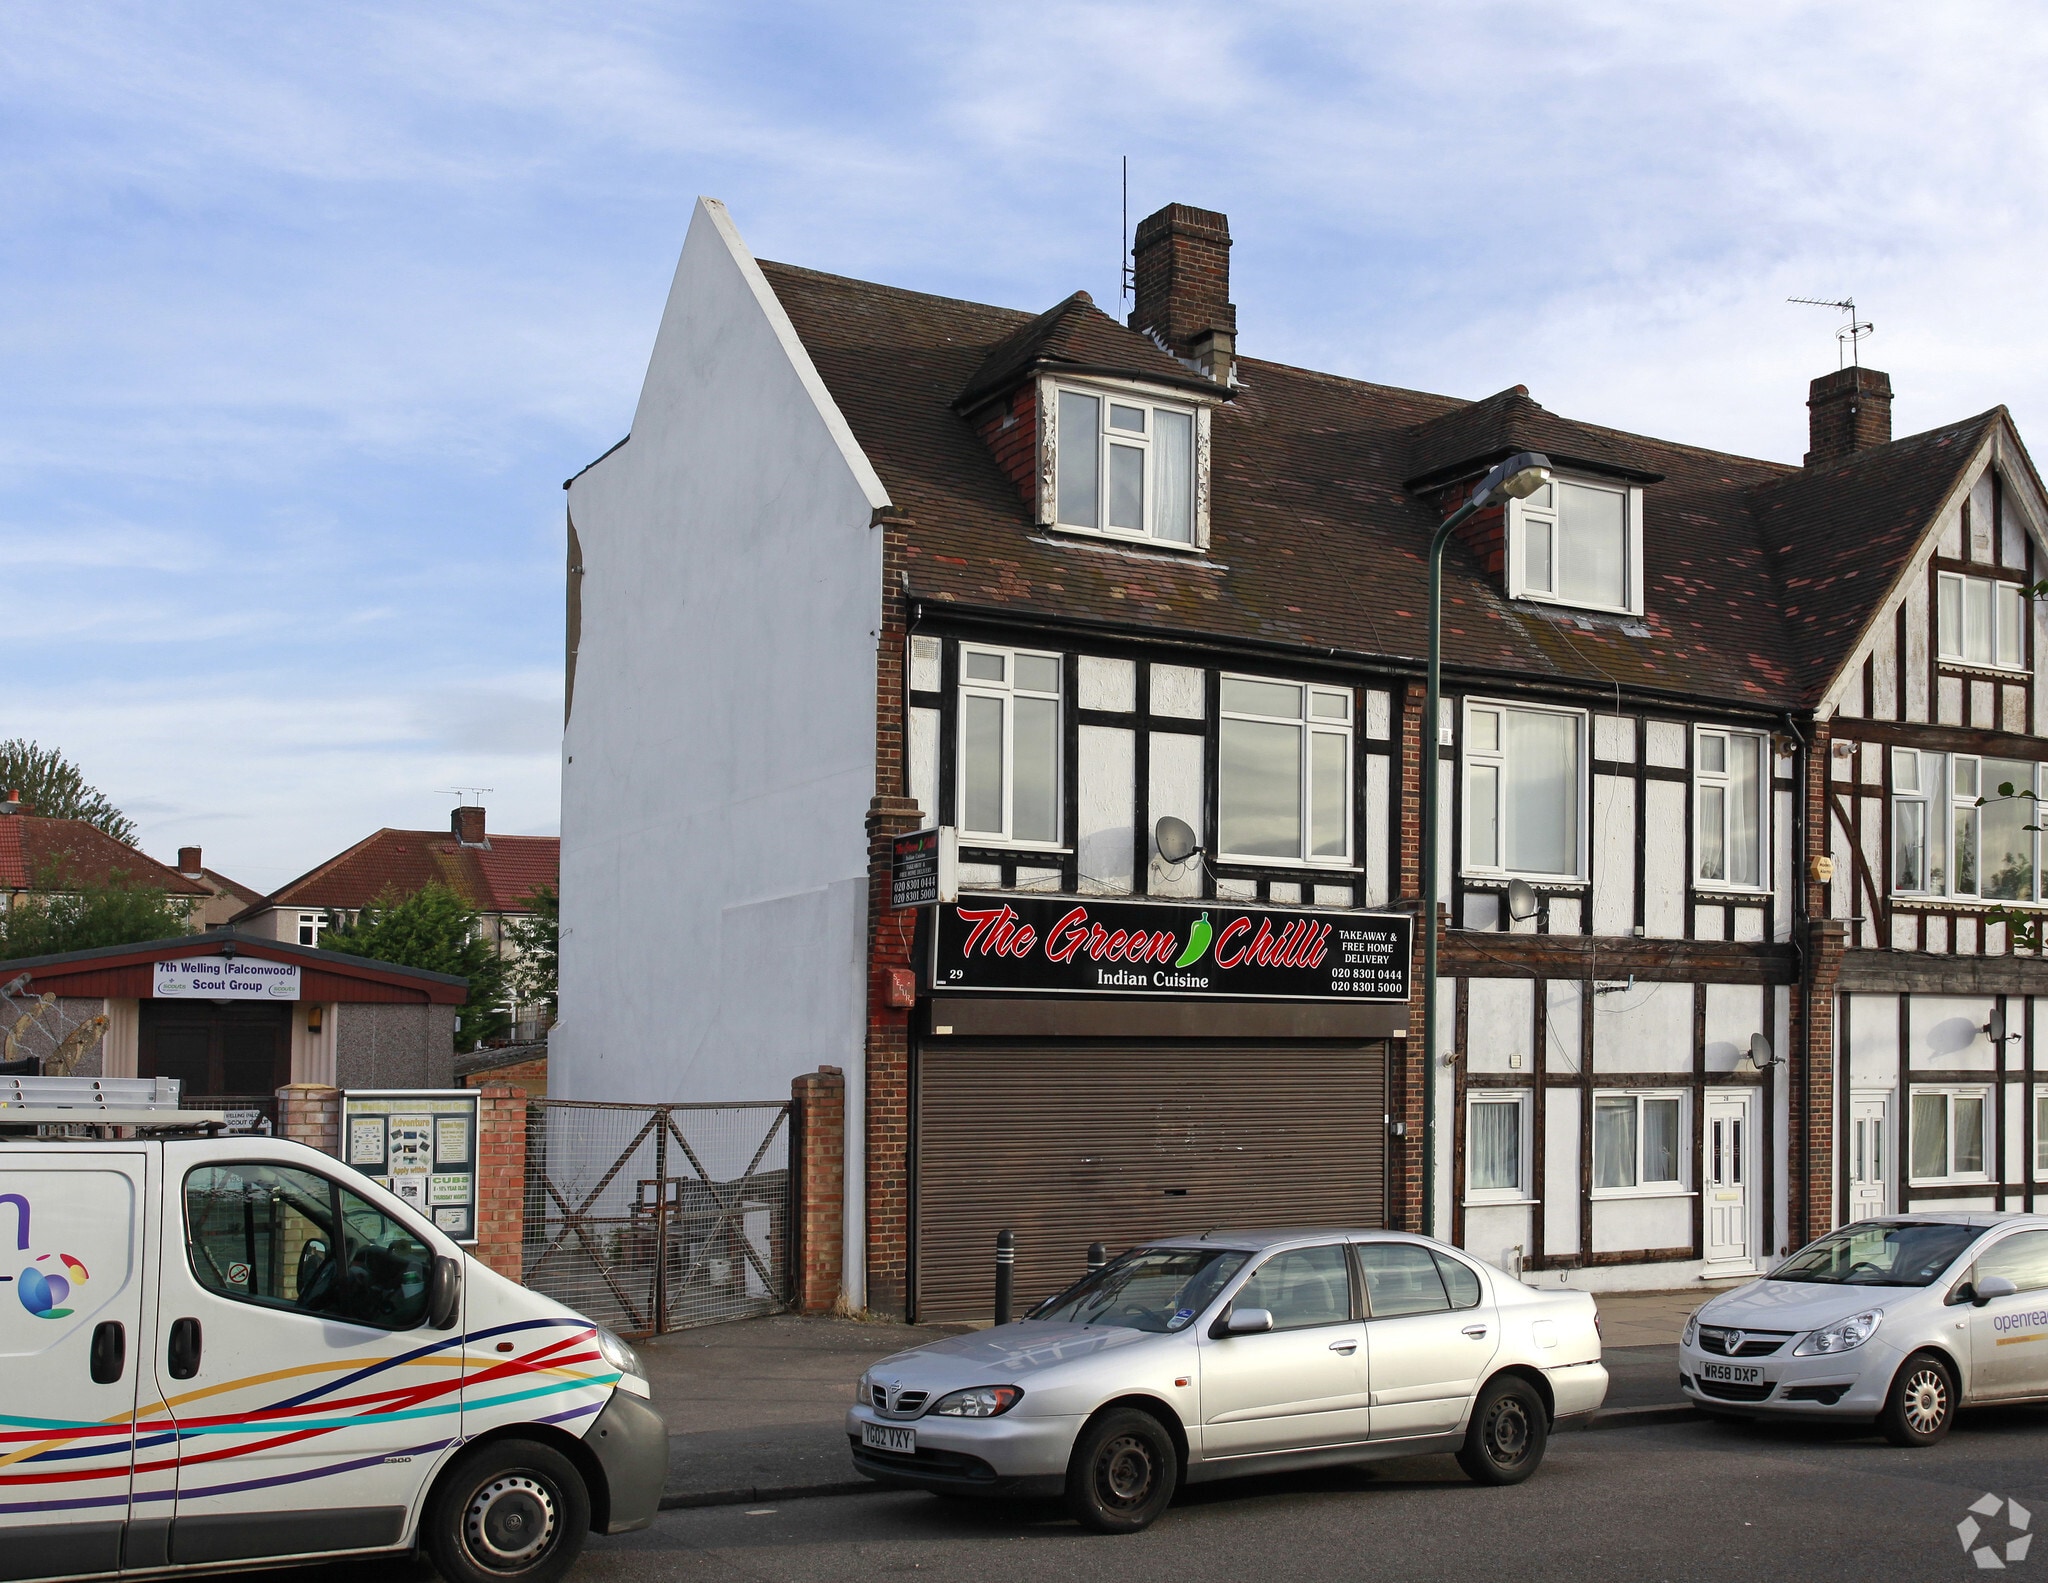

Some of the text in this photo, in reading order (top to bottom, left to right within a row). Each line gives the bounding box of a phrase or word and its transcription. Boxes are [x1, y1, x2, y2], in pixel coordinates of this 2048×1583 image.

[894, 876, 936, 892] 020 8301 0444
[893, 888, 936, 904] 020 8301 5000
[956, 902, 1333, 970] The Green Chilli
[1338, 930, 1398, 942] TAKEAWAY &
[1342, 941, 1394, 953] FREE HOME
[1344, 953, 1390, 965] DELIVERY
[158, 962, 297, 976] 7th Welling (Falconwood)
[949, 969, 964, 980] 29
[1331, 967, 1402, 980] 020 8301 0444
[192, 979, 263, 993] Scout Group
[1096, 969, 1209, 989] Indian Cuisine
[1331, 981, 1402, 993] 020 8301 5000
[392, 1118, 430, 1127] Adventure
[393, 1167, 409, 1175] Apply
[1994, 1310, 2048, 1333] openrea
[1704, 1363, 1758, 1382] WR58 DXP
[865, 1425, 910, 1449] YG02 VXY
